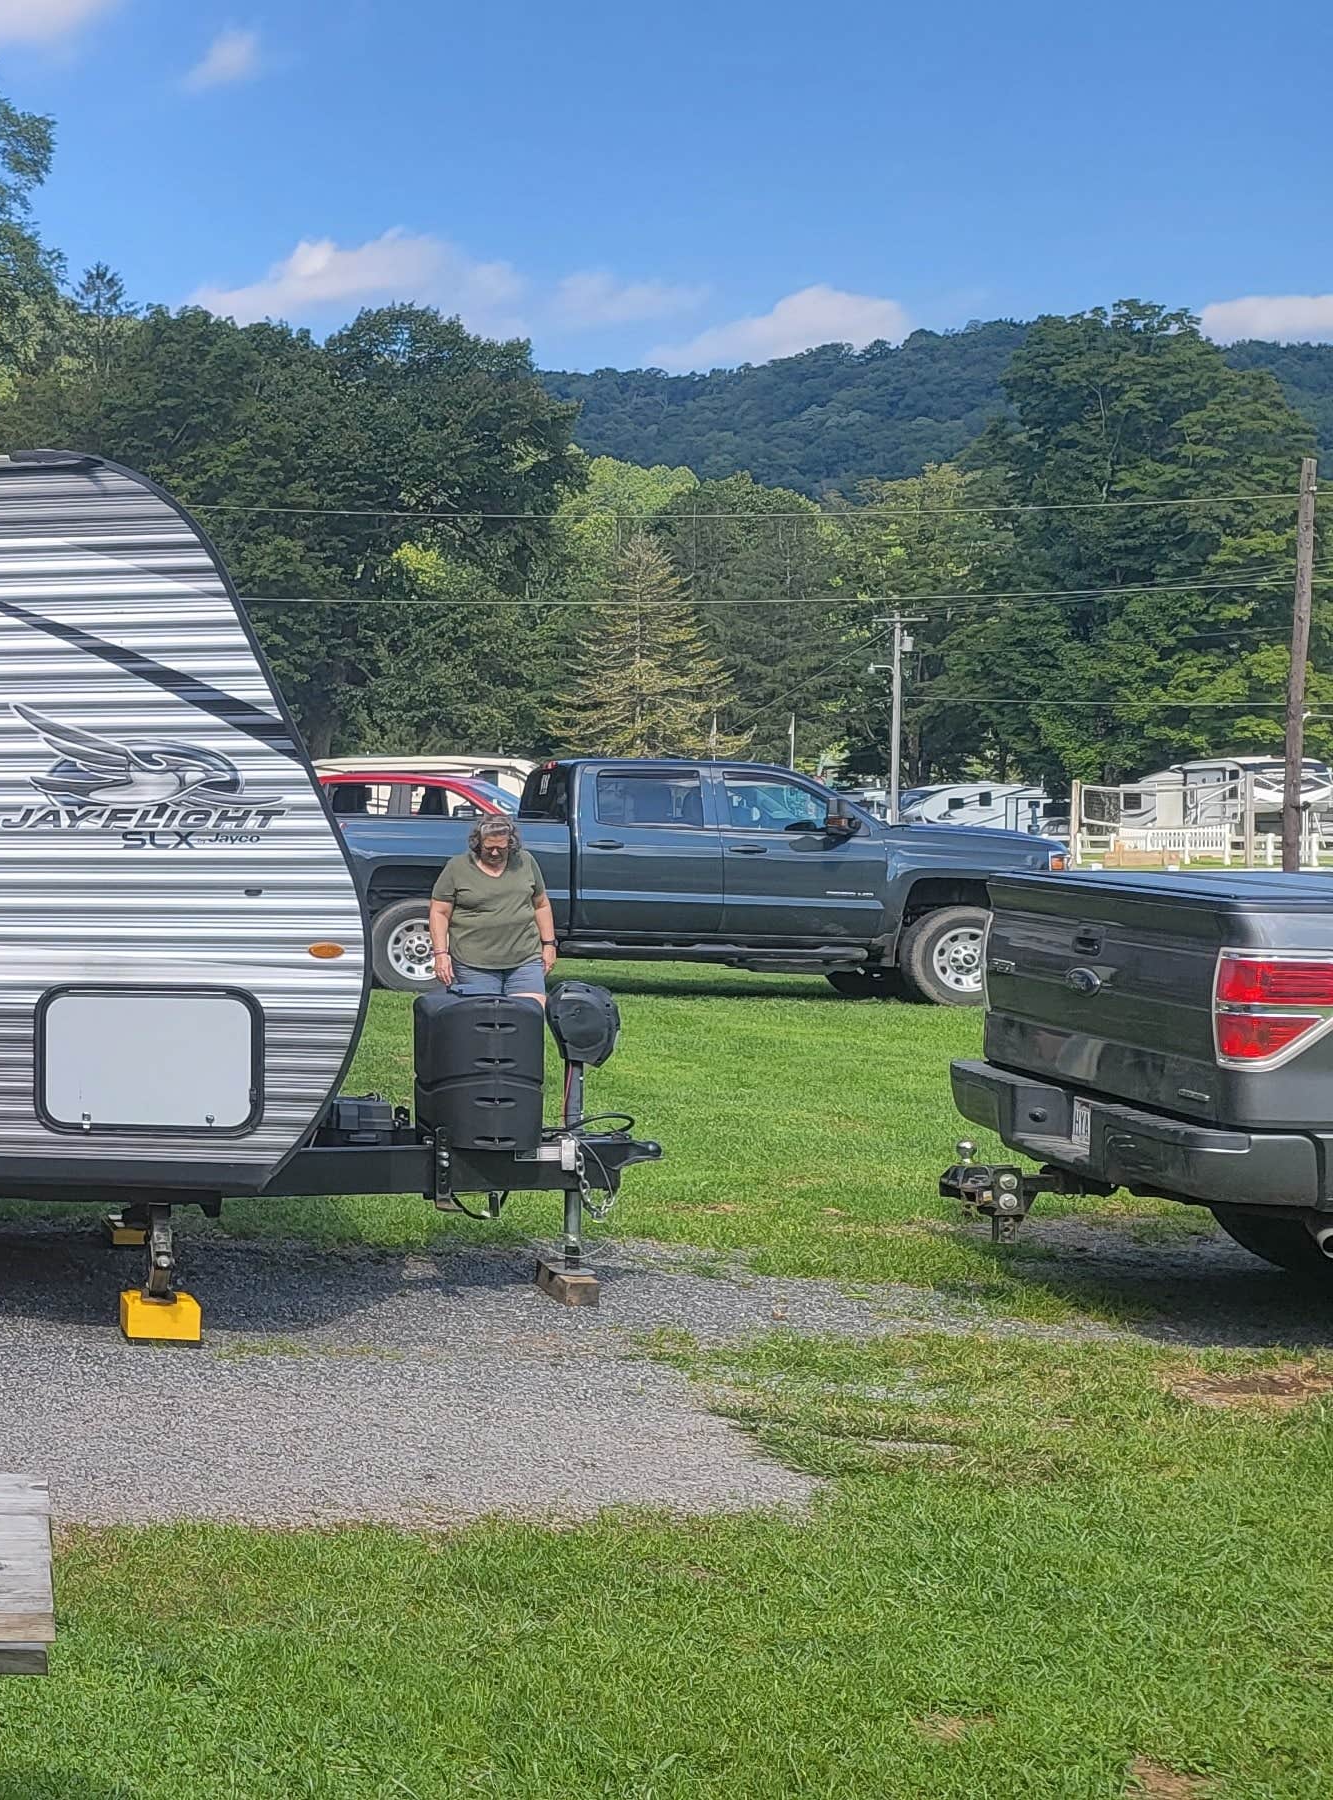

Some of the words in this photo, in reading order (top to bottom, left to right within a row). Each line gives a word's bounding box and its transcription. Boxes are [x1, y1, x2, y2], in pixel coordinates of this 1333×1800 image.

[0, 806, 96, 830] JAY
[100, 807, 287, 831] FLIGHT
[121, 830, 197, 849] SLX
[207, 832, 261, 845] Jayco
